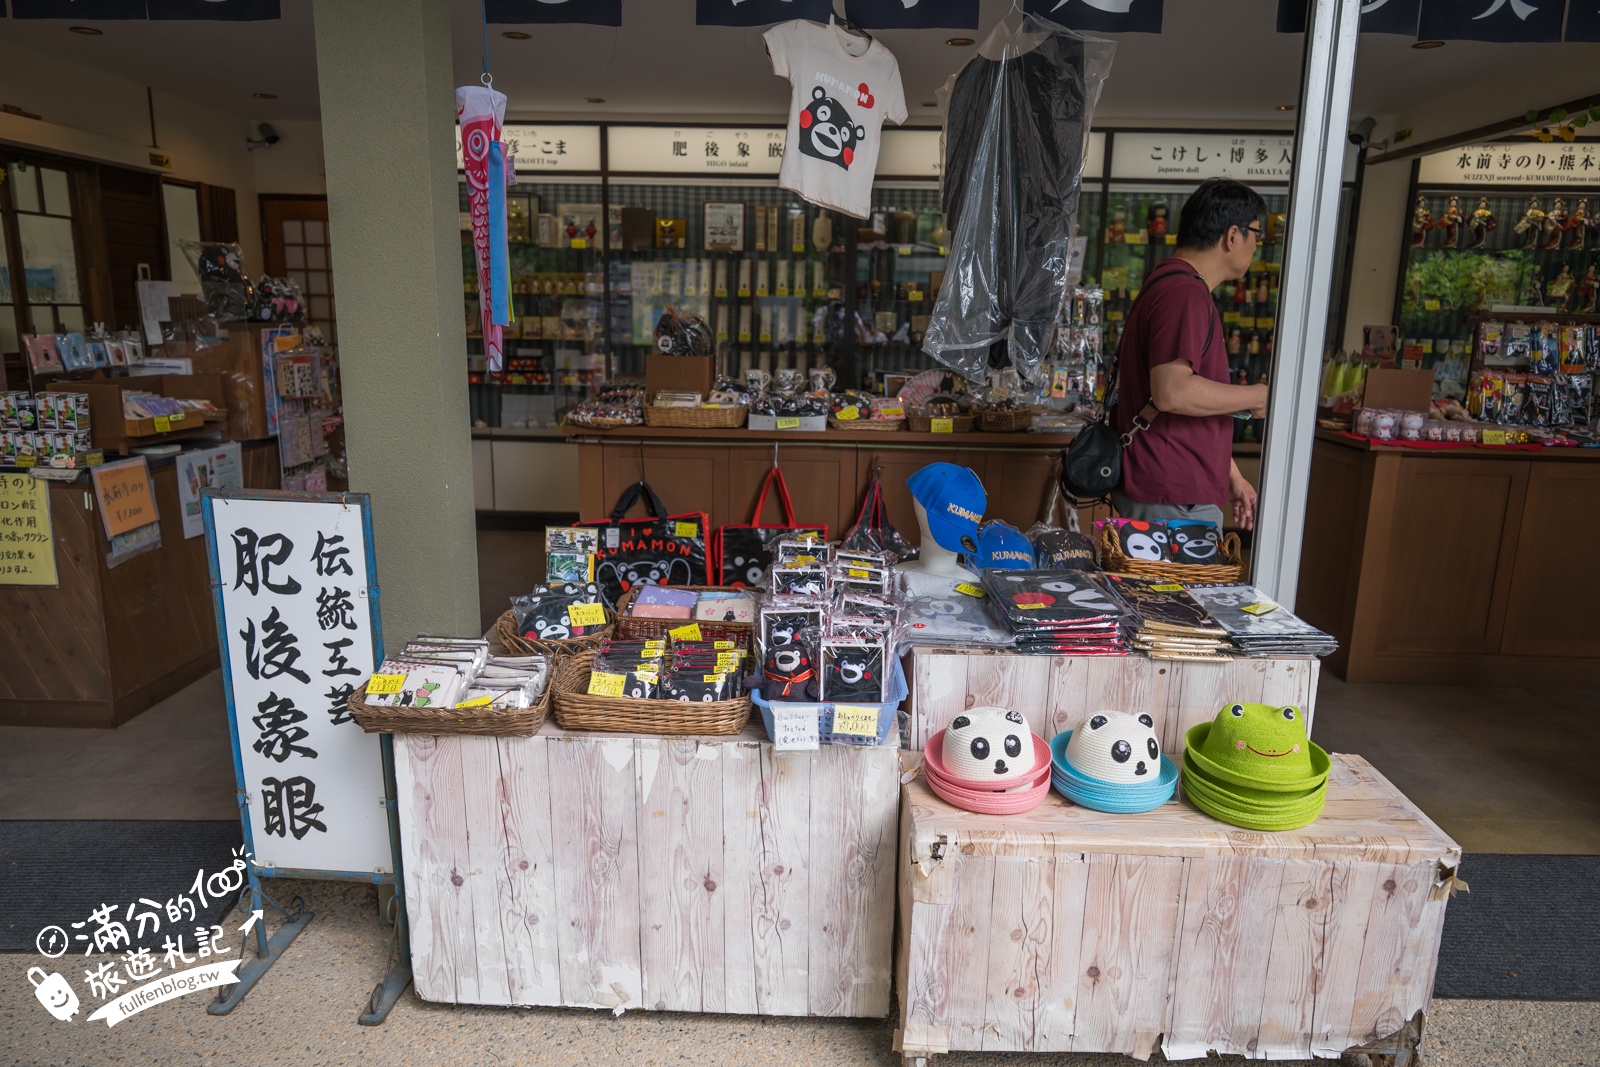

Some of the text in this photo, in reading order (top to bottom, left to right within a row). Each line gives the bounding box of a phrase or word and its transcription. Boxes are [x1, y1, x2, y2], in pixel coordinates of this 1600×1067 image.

[814, 71, 869, 104] KUMAMON
[1456, 153, 1600, 171] 水前寺のり・熊本
[1464, 174, 1495, 182] SUIZENJI
[596, 539, 691, 561] KUMAMON
[310, 530, 362, 726] 伝統工芸
[230, 526, 328, 841] 肥後象眼
